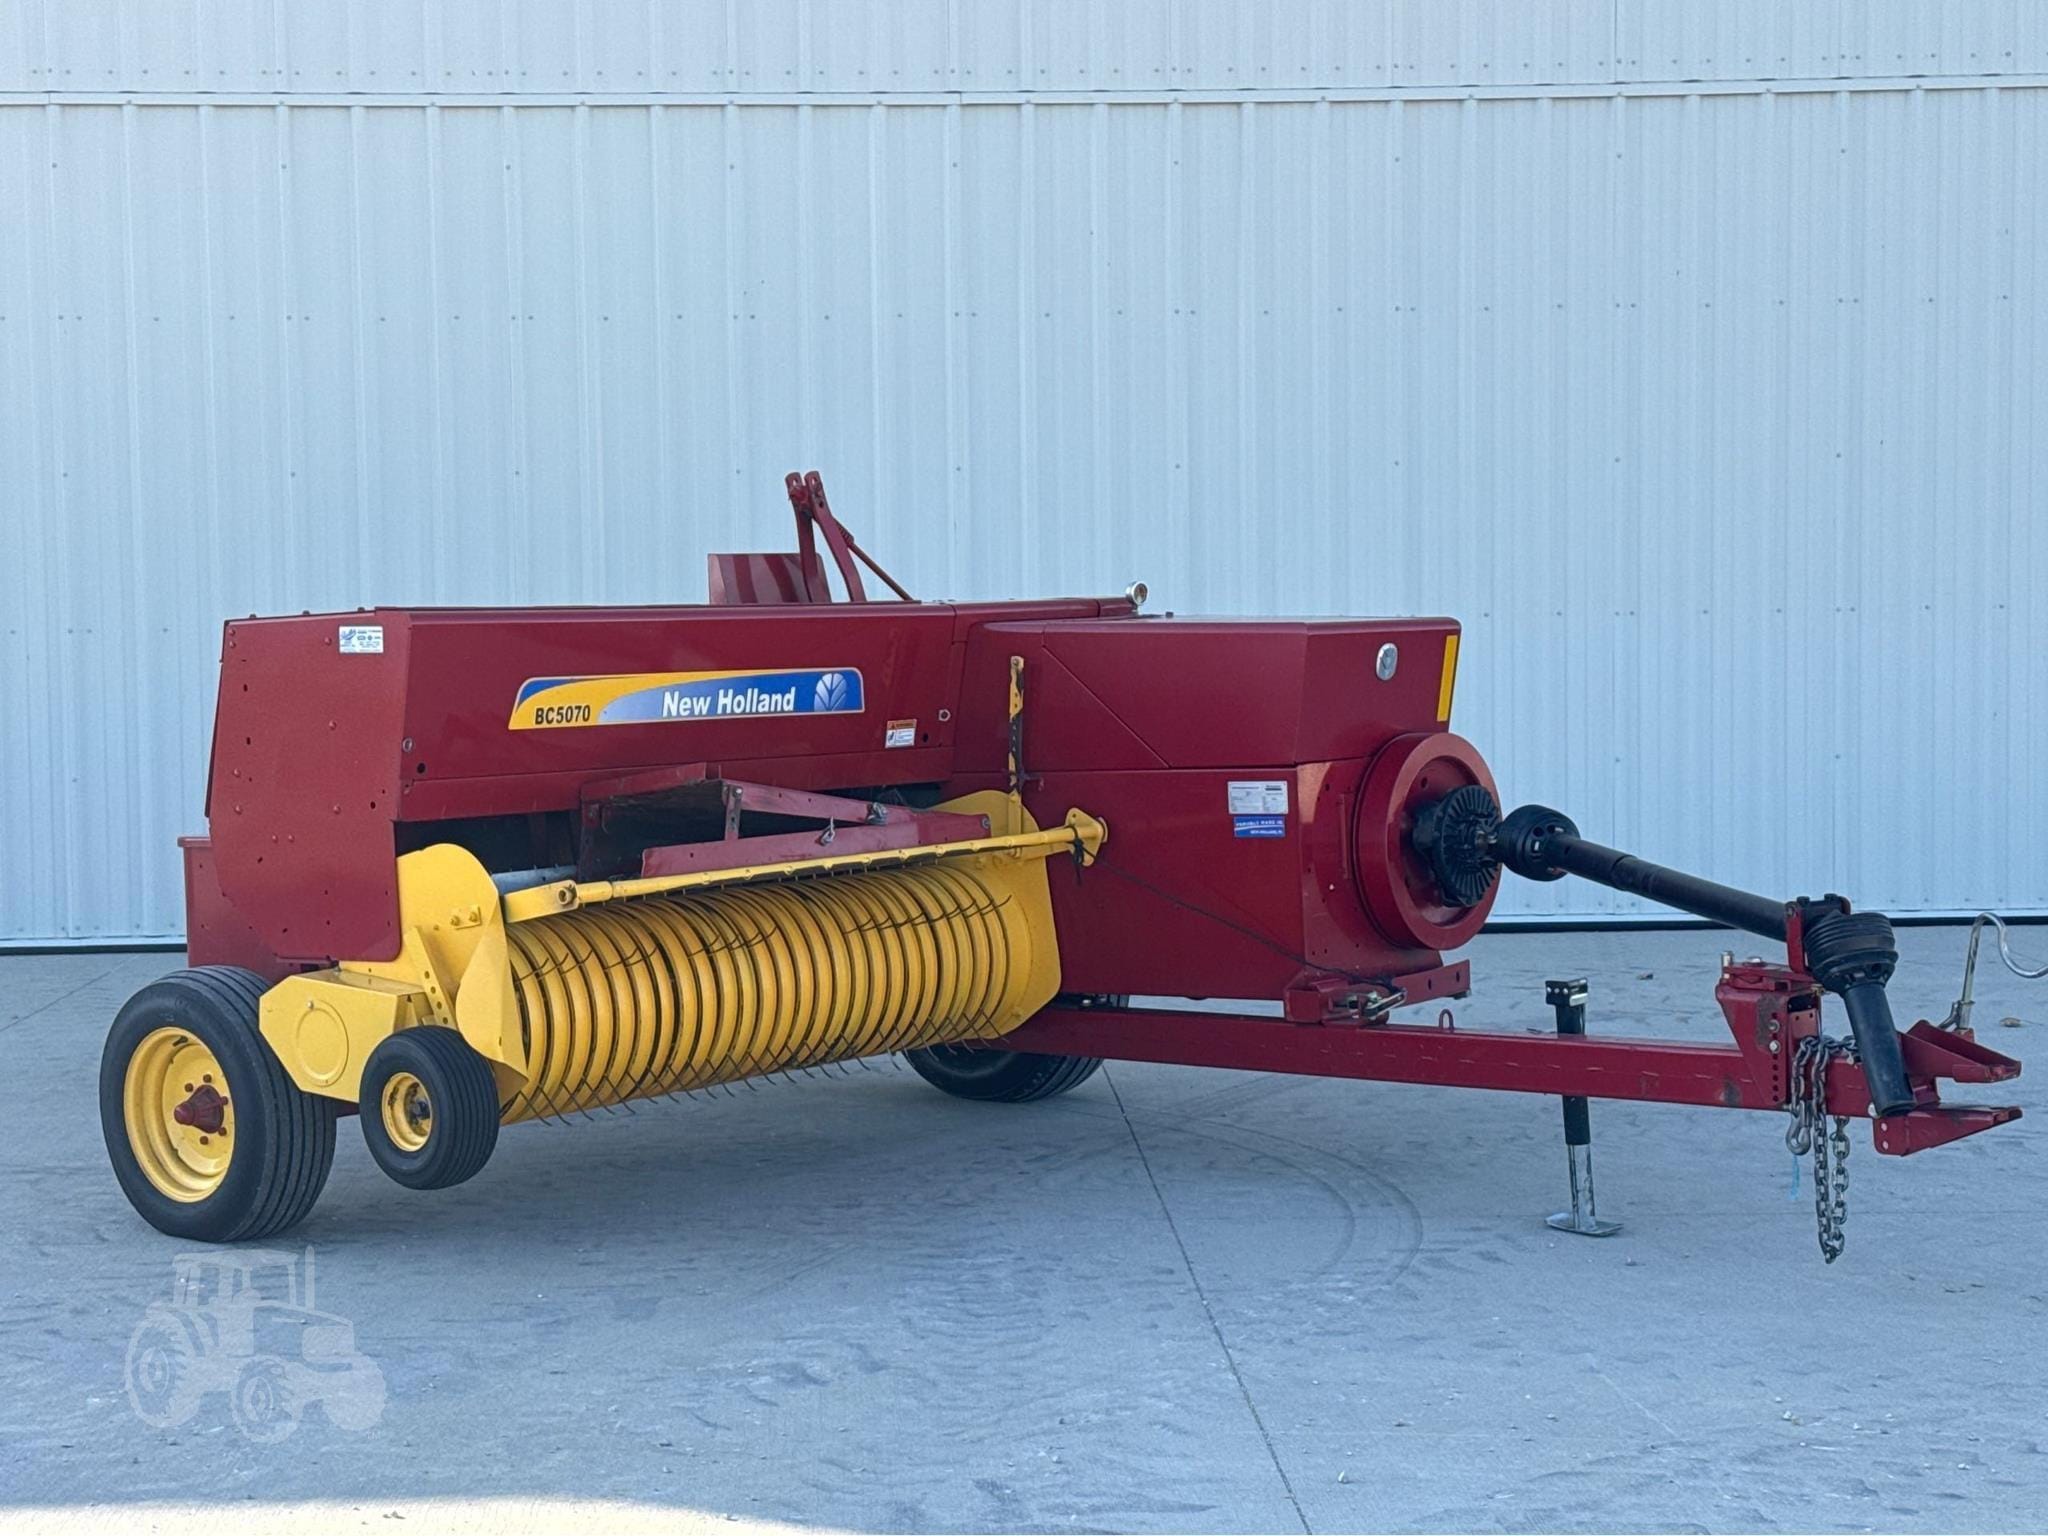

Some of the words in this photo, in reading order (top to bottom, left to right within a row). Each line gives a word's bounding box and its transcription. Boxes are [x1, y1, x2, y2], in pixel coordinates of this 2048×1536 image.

[535, 704, 591, 725] BC5070
[662, 690, 712, 718] New
[716, 686, 796, 714] Holland
